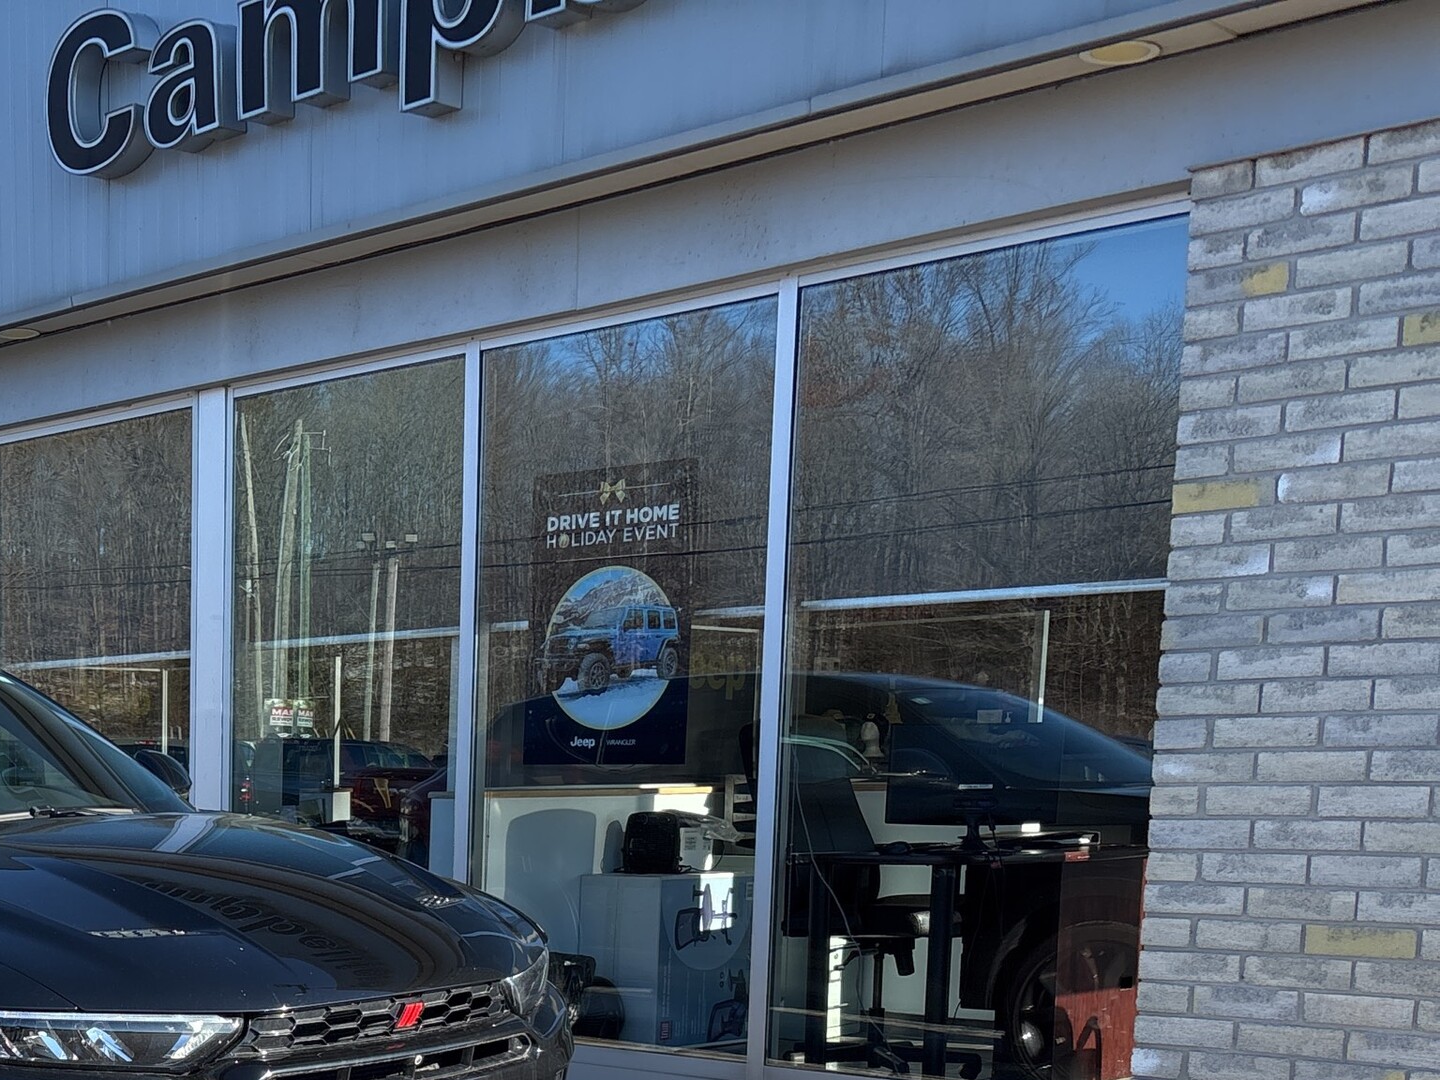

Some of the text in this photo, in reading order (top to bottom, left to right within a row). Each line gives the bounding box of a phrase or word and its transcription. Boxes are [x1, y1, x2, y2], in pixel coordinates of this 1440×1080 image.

[547, 503, 680, 532] DRIVE IT HOME
[546, 522, 679, 549] HOLIDAY EVENT
[570, 736, 595, 749] Jeep
